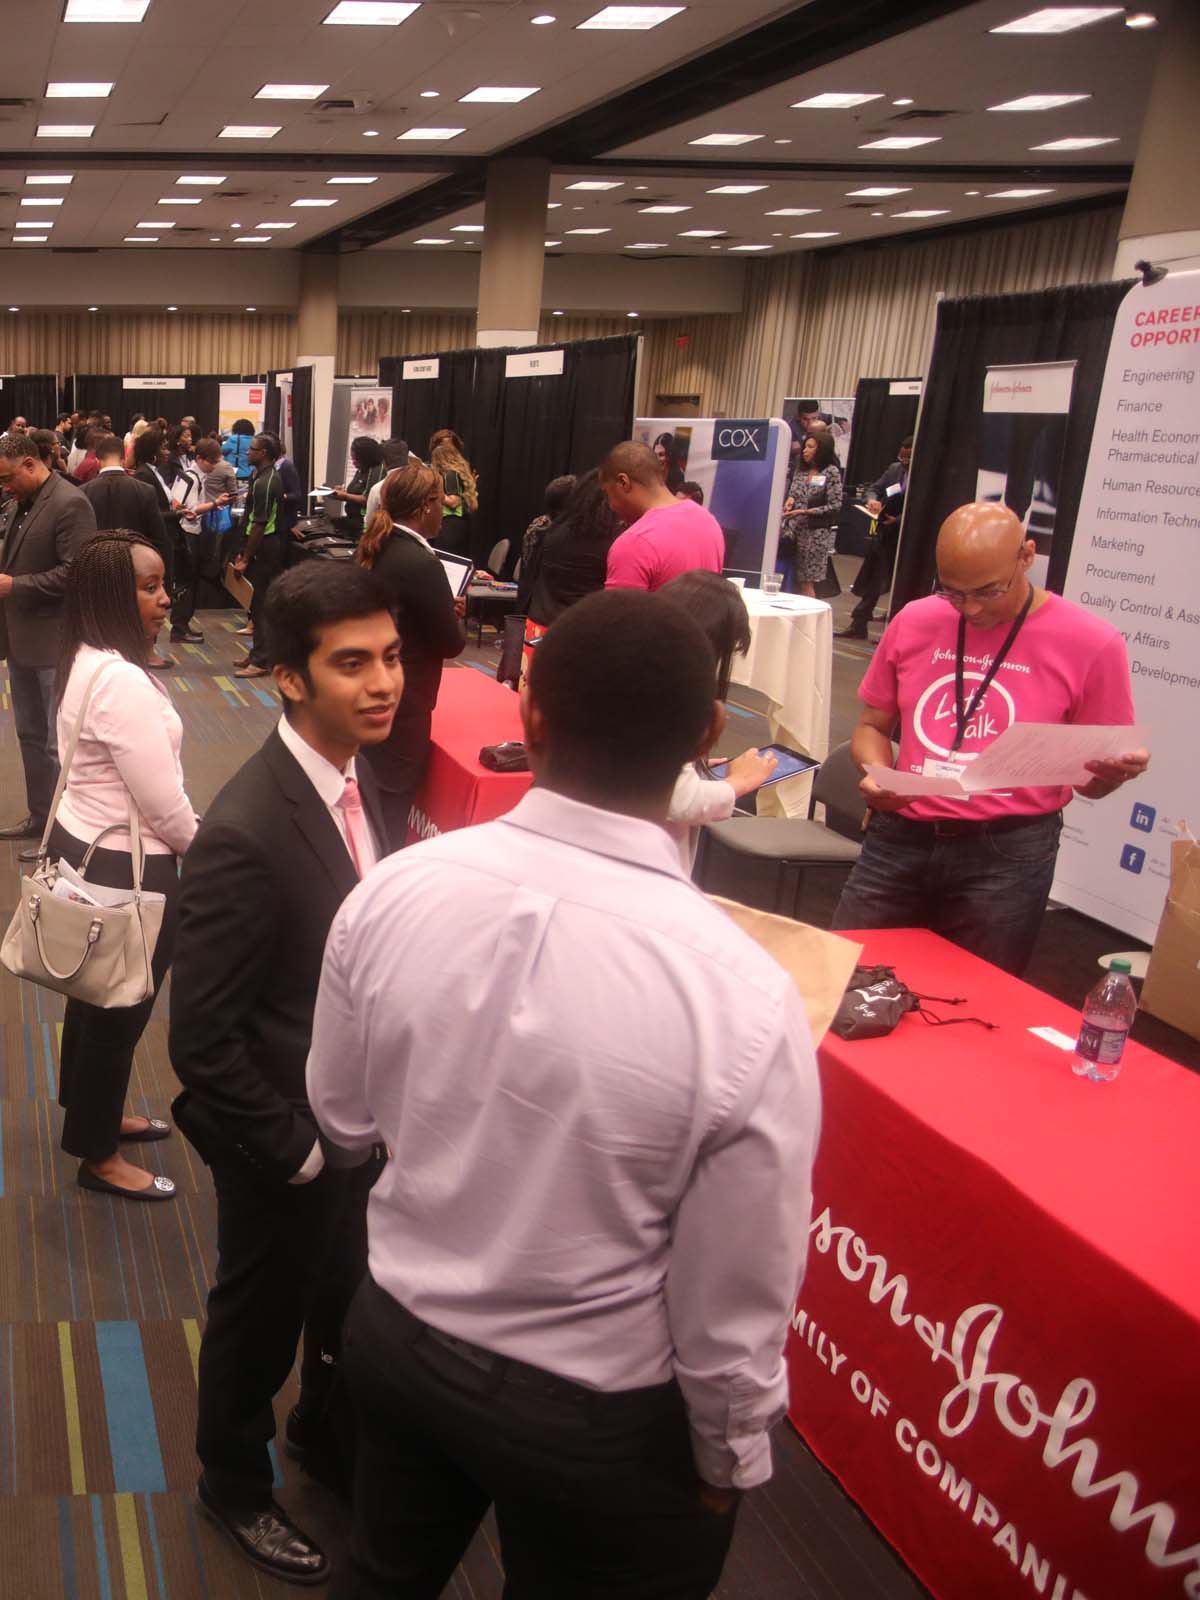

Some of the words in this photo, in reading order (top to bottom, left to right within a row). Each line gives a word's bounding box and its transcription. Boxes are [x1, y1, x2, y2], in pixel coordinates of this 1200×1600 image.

[1122, 368, 1195, 386] Engineering
[1116, 399, 1163, 412] Finance
[718, 428, 760, 452] COX
[1111, 429, 1148, 443] Health
[1107, 448, 1199, 465] Pharmaceutical
[1102, 478, 1142, 493] Human
[1096, 506, 1158, 525] Information
[1091, 535, 1145, 556] Marketing
[1086, 563, 1156, 586] Procurement
[1080, 592, 1117, 612] Quality
[1119, 598, 1162, 618] Control
[1165, 606, 1174, 620] &
[1133, 631, 1170, 650] Affairs
[850, 1369, 890, 1417] OF
